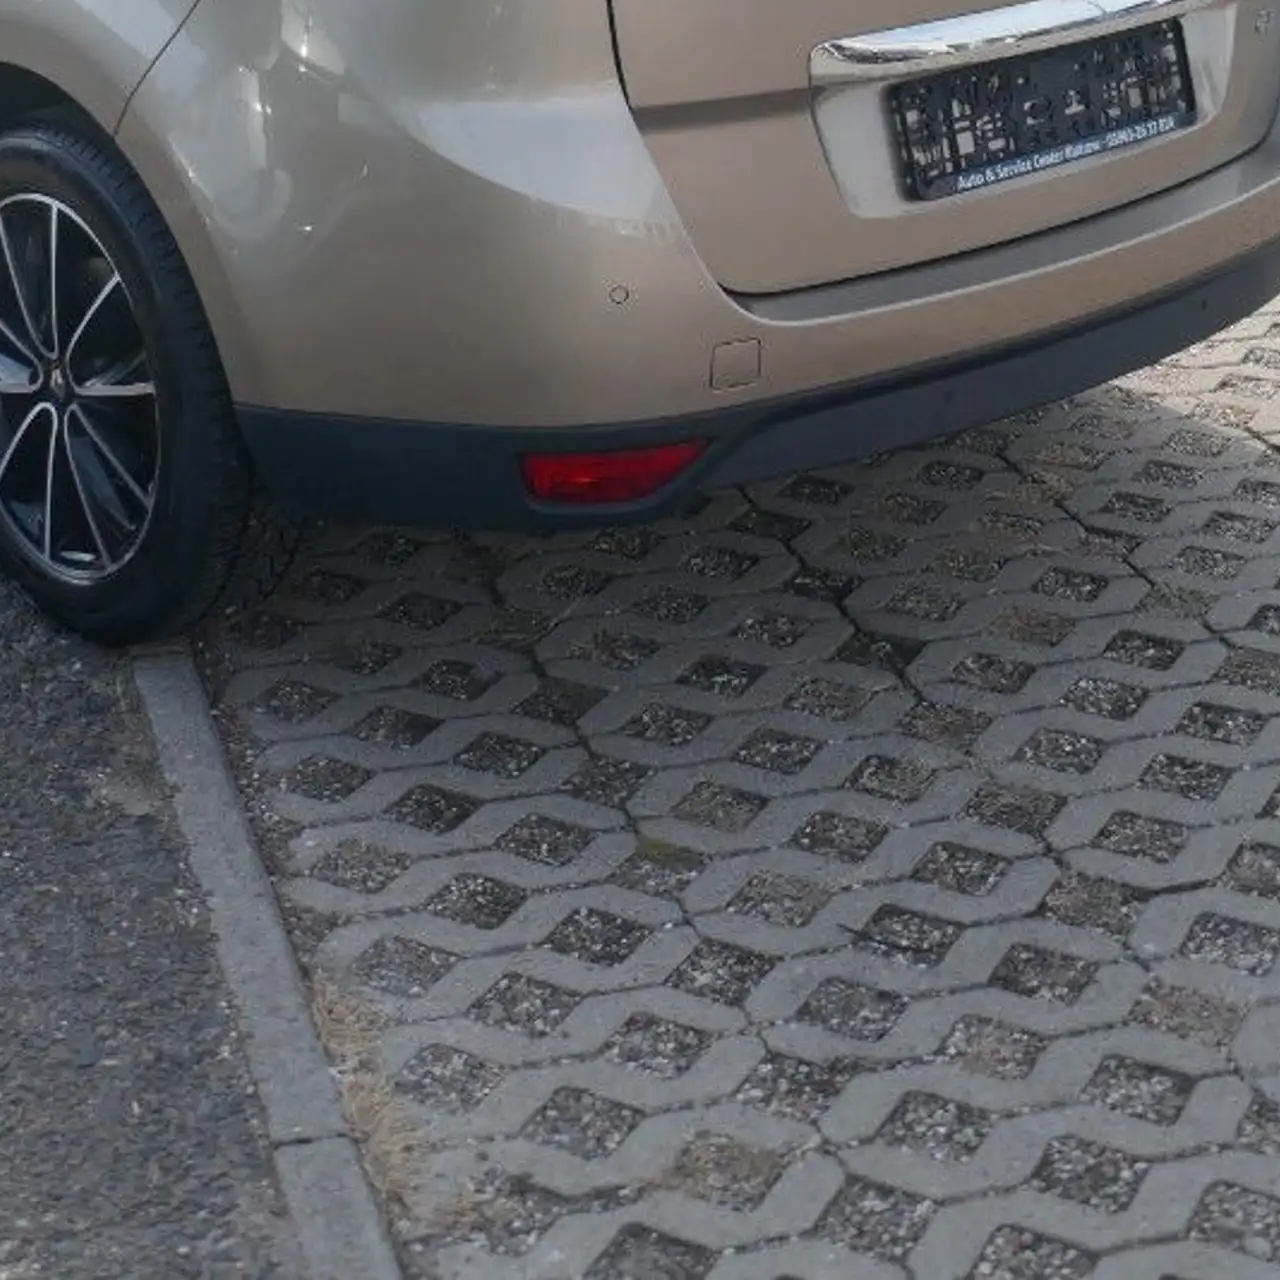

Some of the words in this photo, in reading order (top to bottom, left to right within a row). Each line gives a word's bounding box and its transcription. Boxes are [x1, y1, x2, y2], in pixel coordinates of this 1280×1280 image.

[956, 171, 984, 190] Auto
[986, 168, 995, 182] &
[997, 157, 1032, 180] Service
